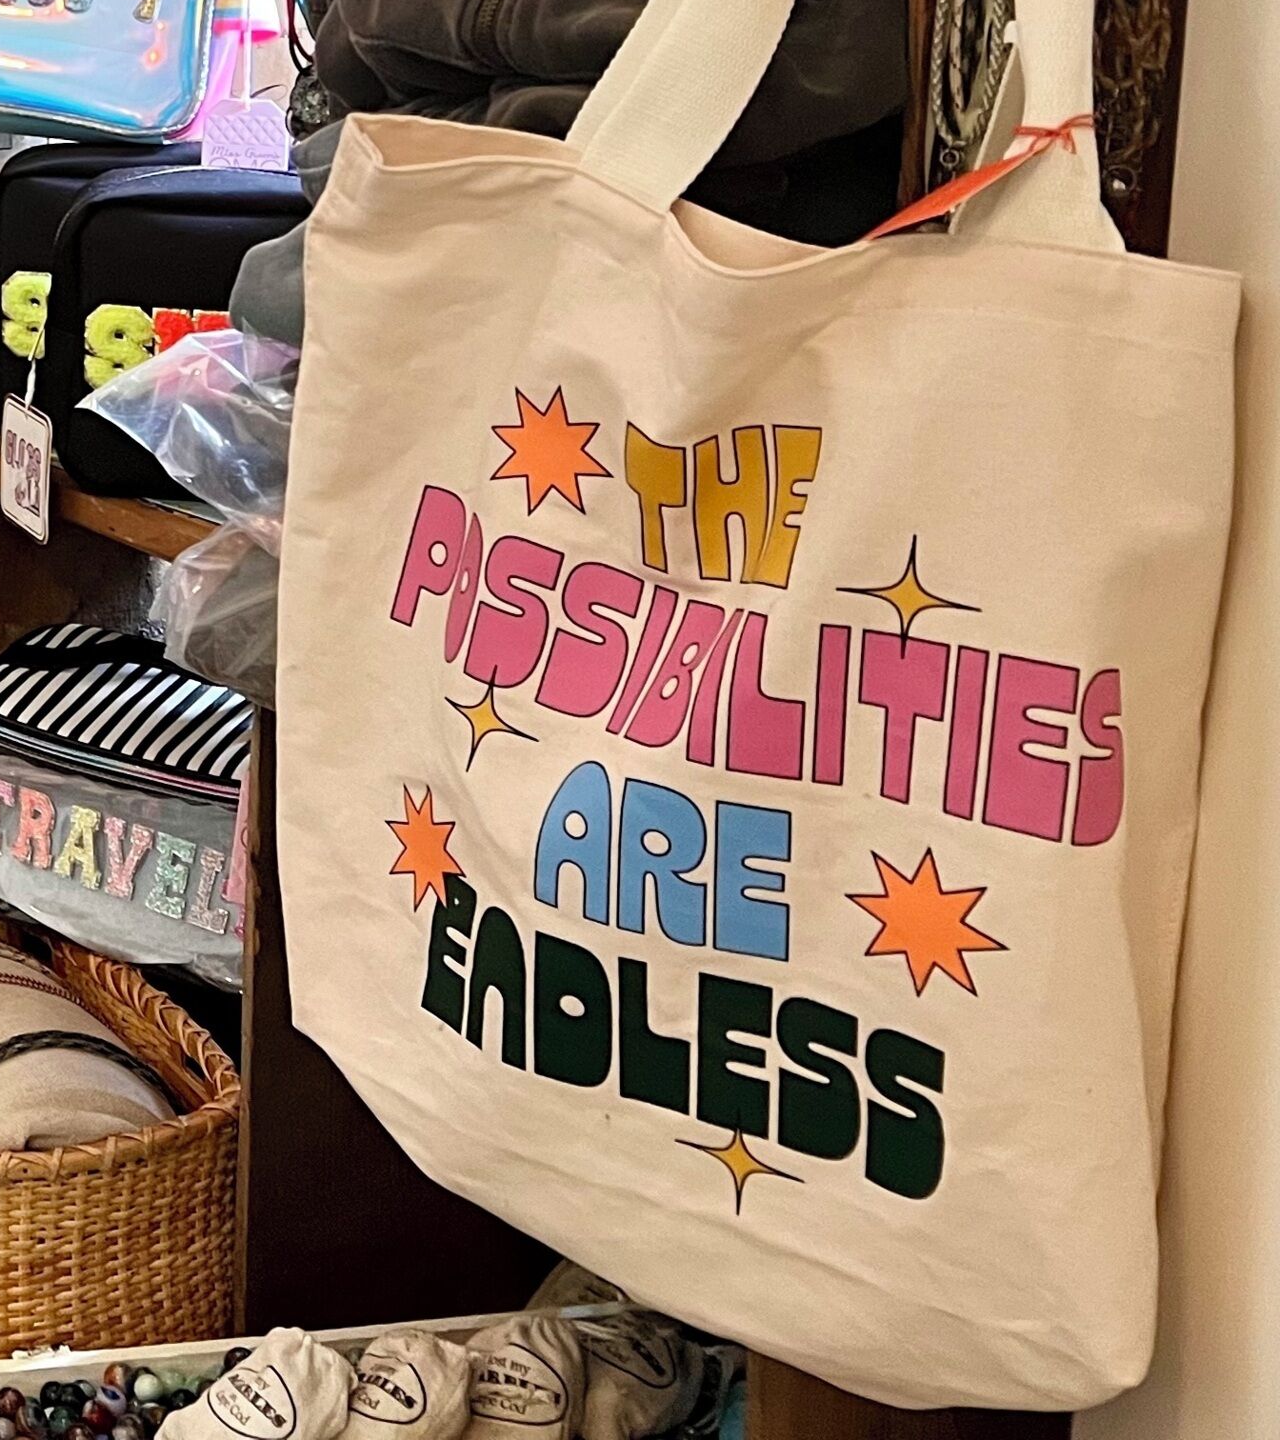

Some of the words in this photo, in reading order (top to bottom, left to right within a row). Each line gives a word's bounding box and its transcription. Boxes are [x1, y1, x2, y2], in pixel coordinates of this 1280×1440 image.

[624, 422, 822, 589] THE
[390, 484, 1124, 848] POSSIBILITIES
[534, 760, 793, 962] ARE
[420, 872, 946, 1201] ENDLESS
